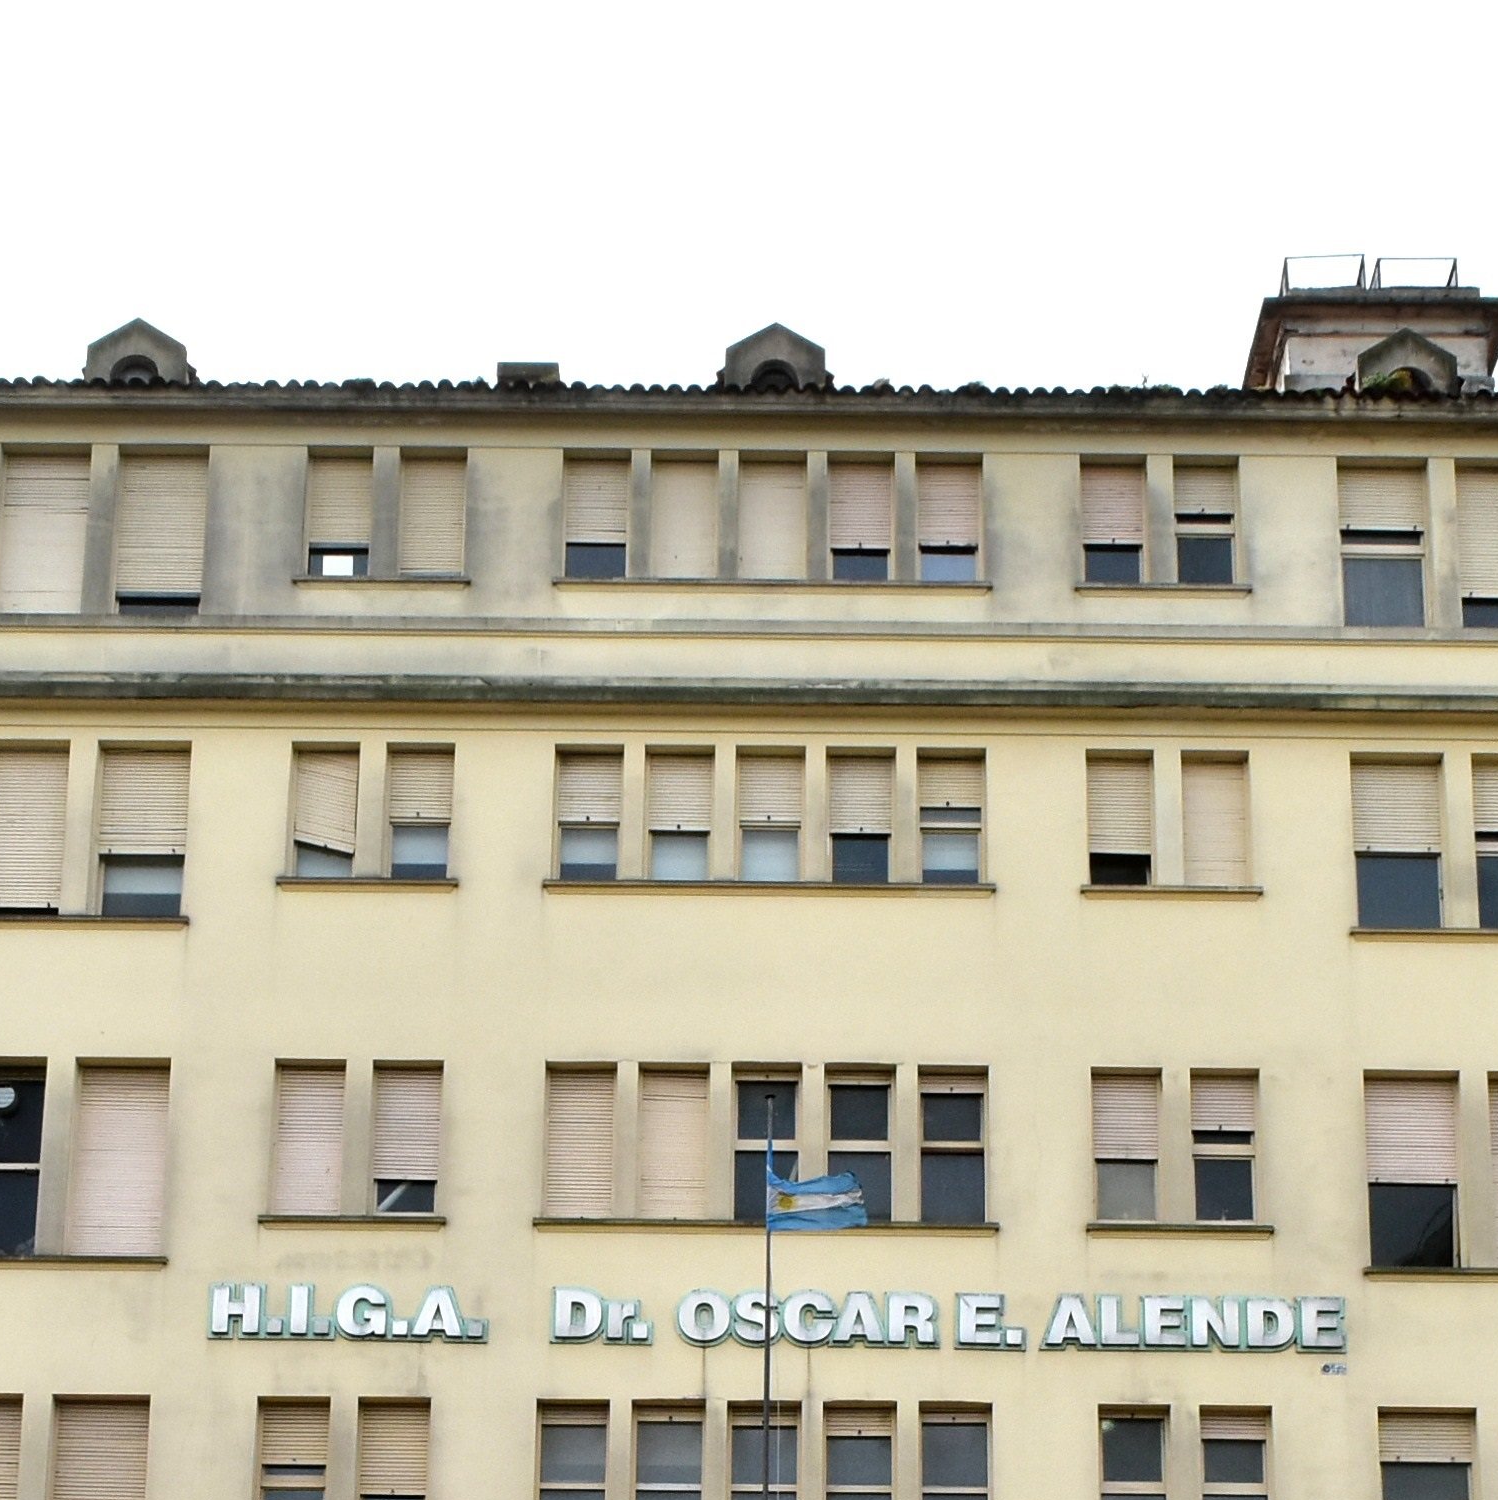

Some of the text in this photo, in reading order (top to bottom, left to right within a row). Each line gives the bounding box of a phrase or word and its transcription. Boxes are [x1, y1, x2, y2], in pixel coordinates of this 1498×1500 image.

[209, 1284, 1346, 1352] H.I.G.A. Dr. OSCAR E. ALENDE
